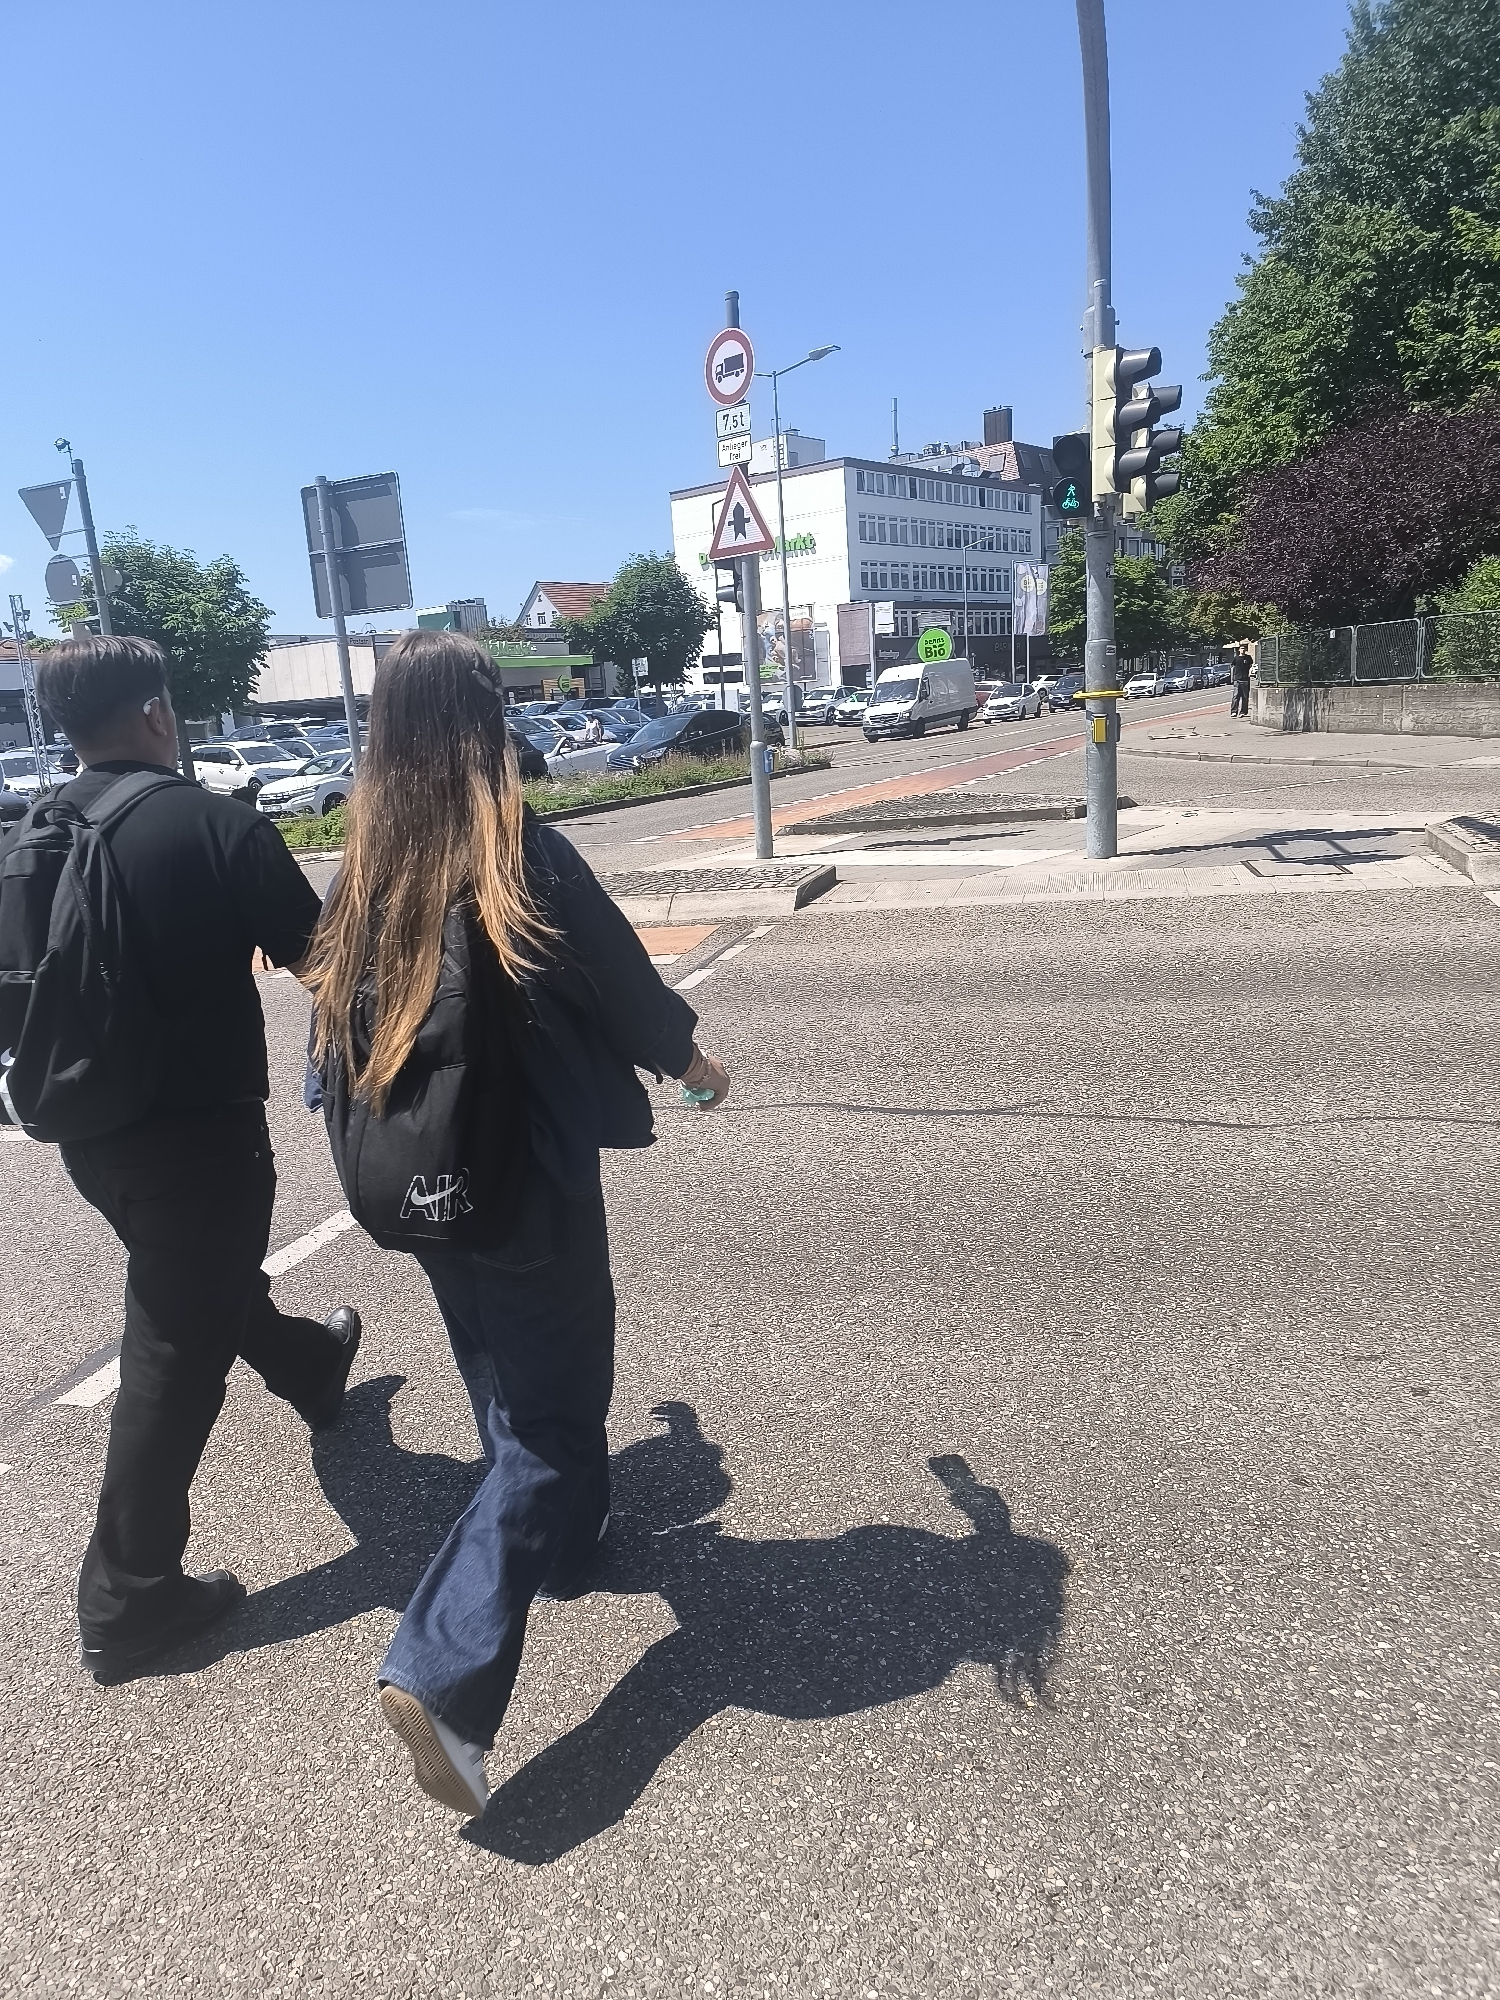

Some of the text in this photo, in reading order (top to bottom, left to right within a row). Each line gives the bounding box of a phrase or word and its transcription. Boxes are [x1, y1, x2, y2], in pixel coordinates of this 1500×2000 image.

[722, 440, 748, 452] Anlieger
[729, 450, 741, 461] frei
[924, 643, 946, 658] Bio
[399, 1167, 474, 1222] AIR
